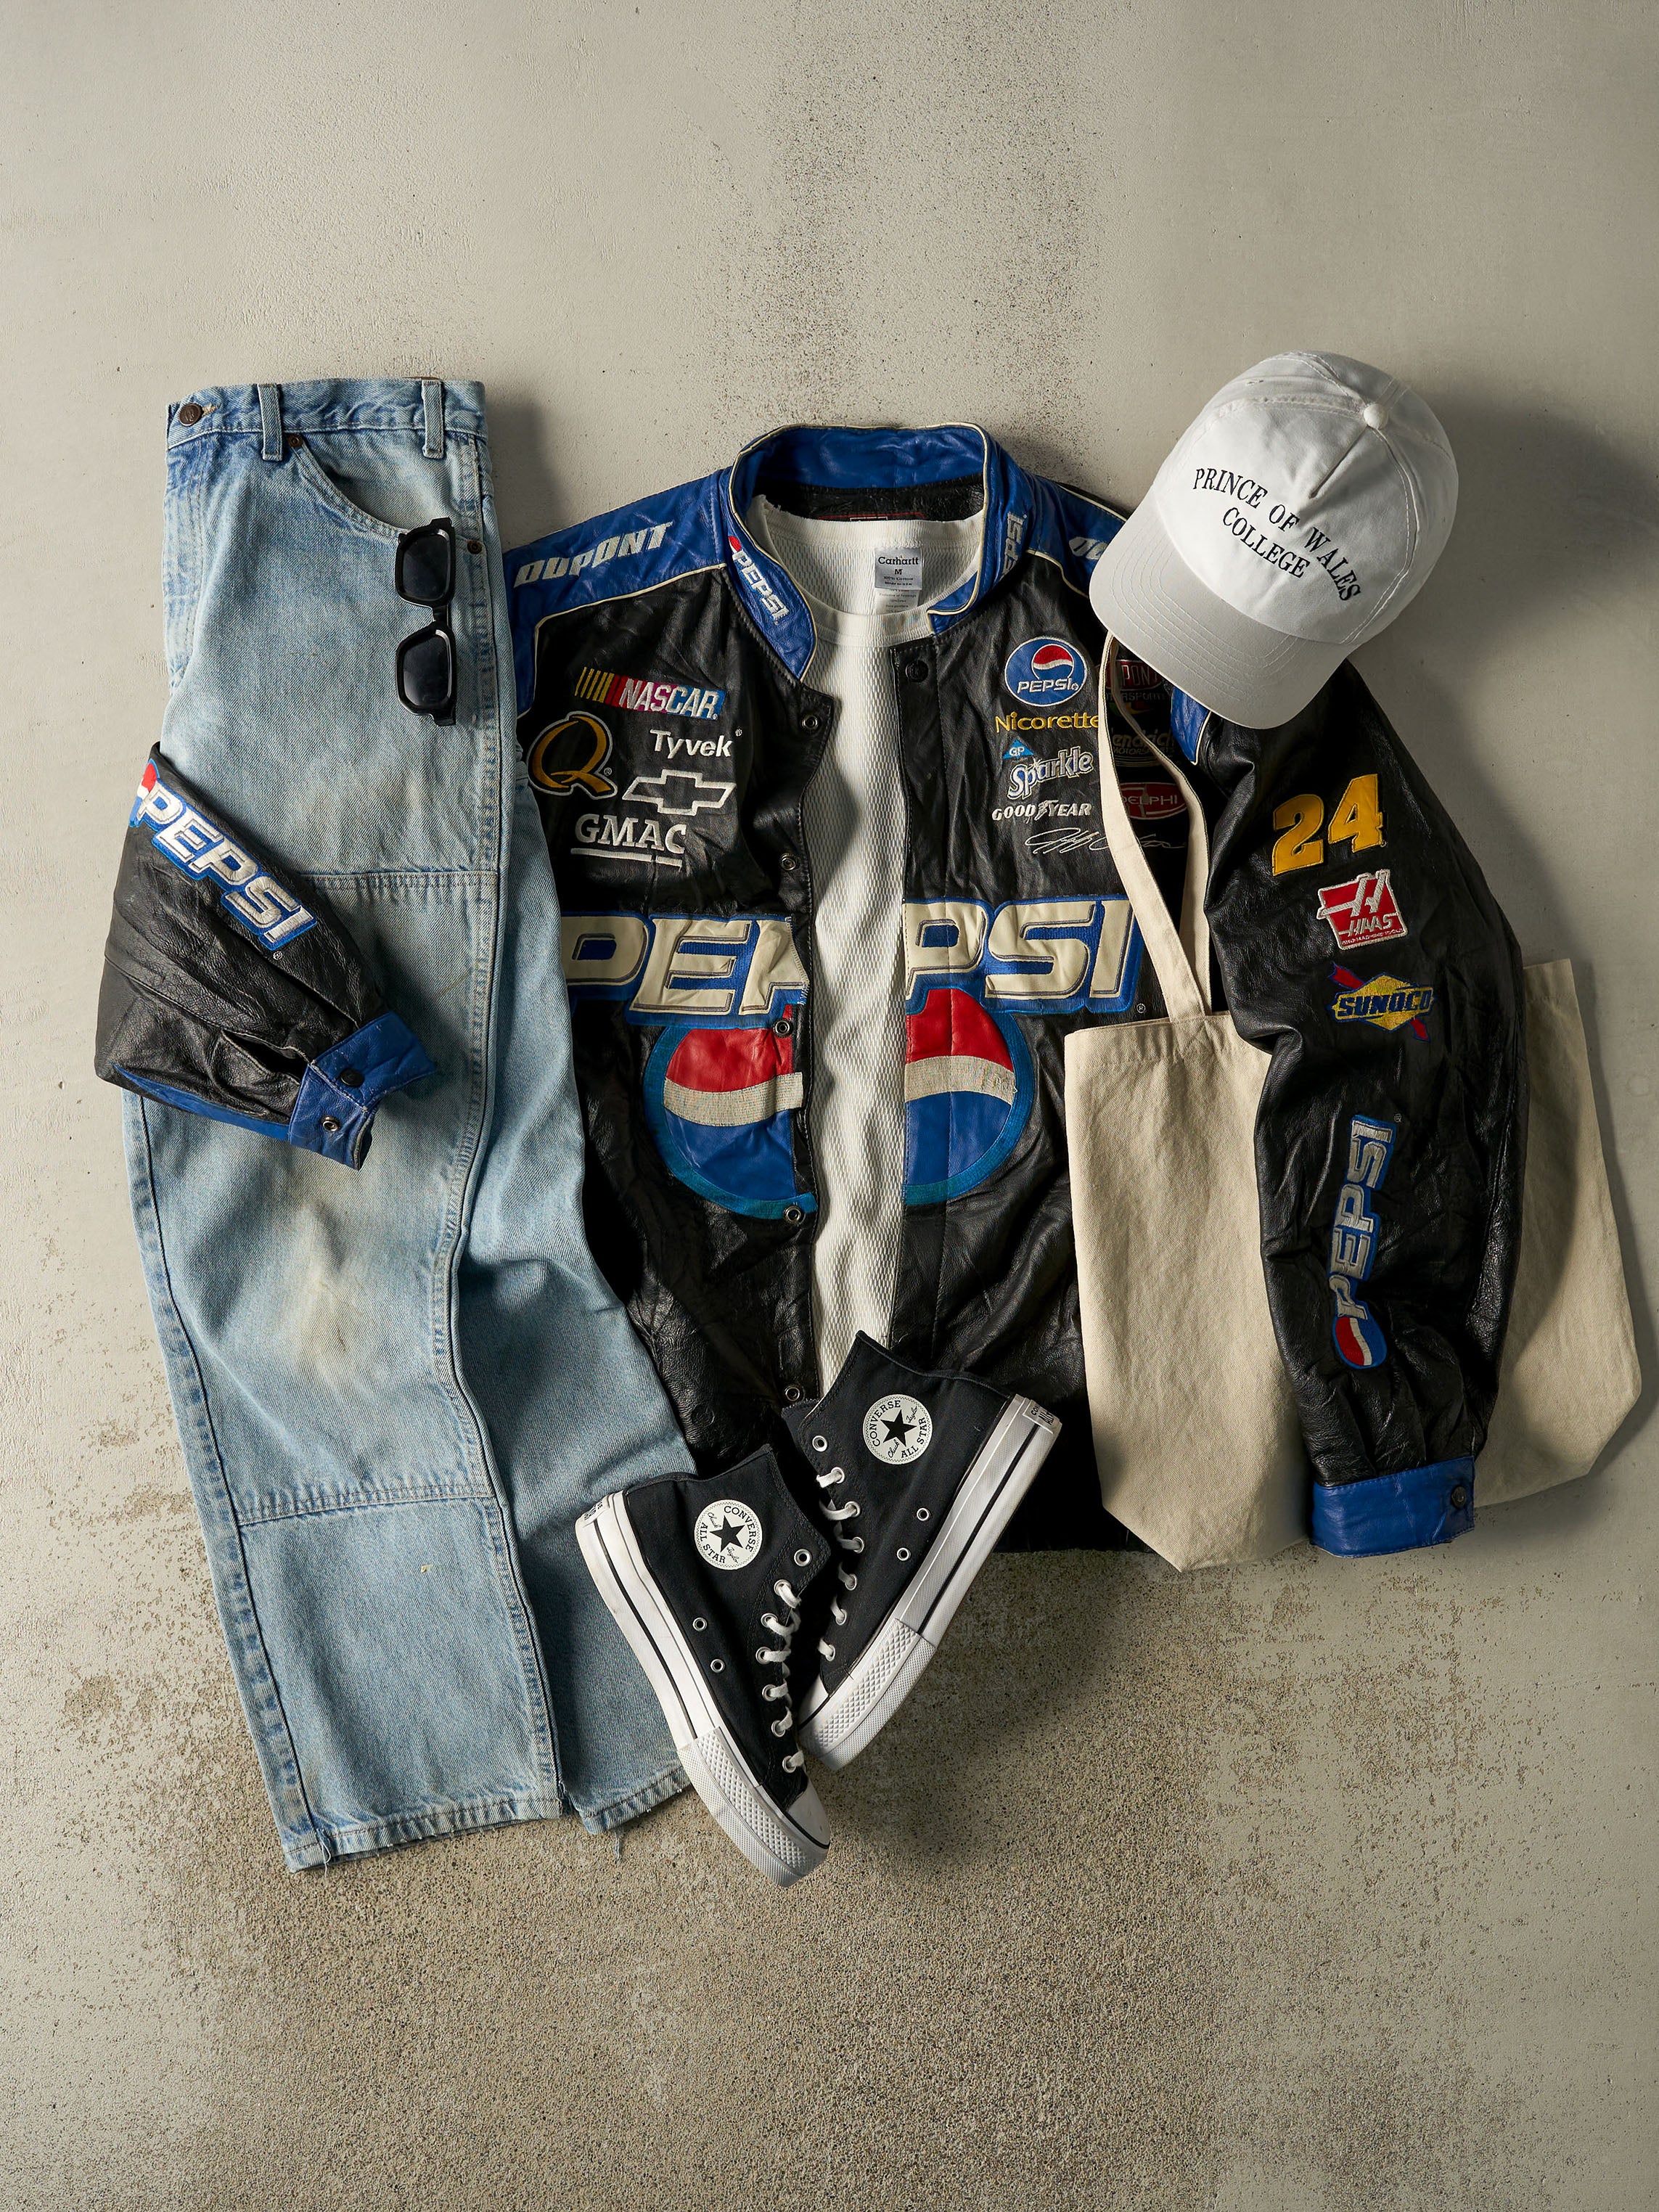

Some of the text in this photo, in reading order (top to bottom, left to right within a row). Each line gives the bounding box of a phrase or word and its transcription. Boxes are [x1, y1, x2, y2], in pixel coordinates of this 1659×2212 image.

[514, 521, 673, 588] DUPONT
[1193, 468, 1361, 601] PRINCE OF WALES
[1222, 507, 1310, 578] COLLEGE
[877, 556, 919, 565] Carhartt
[732, 552, 790, 621] PEPSI
[619, 679, 718, 718] NASCAR
[1017, 678, 1072, 694] PEPSI
[528, 712, 617, 798] Q
[650, 729, 732, 759] Tyvek
[1007, 746, 1094, 800] Sparkle
[575, 814, 687, 854] GMAC
[1272, 774, 1383, 876] 24
[136, 780, 314, 943] PEPSI
[1344, 912, 1396, 937] HAAS
[1339, 989, 1433, 1017] SUNOCO
[1329, 1121, 1393, 1319] PEPSI
[869, 1400, 901, 1446] CONVERSE
[901, 1417, 927, 1458] ALL STAR
[700, 1522, 726, 1563] ALL STAR
[724, 1505, 756, 1552] CONVERSE
